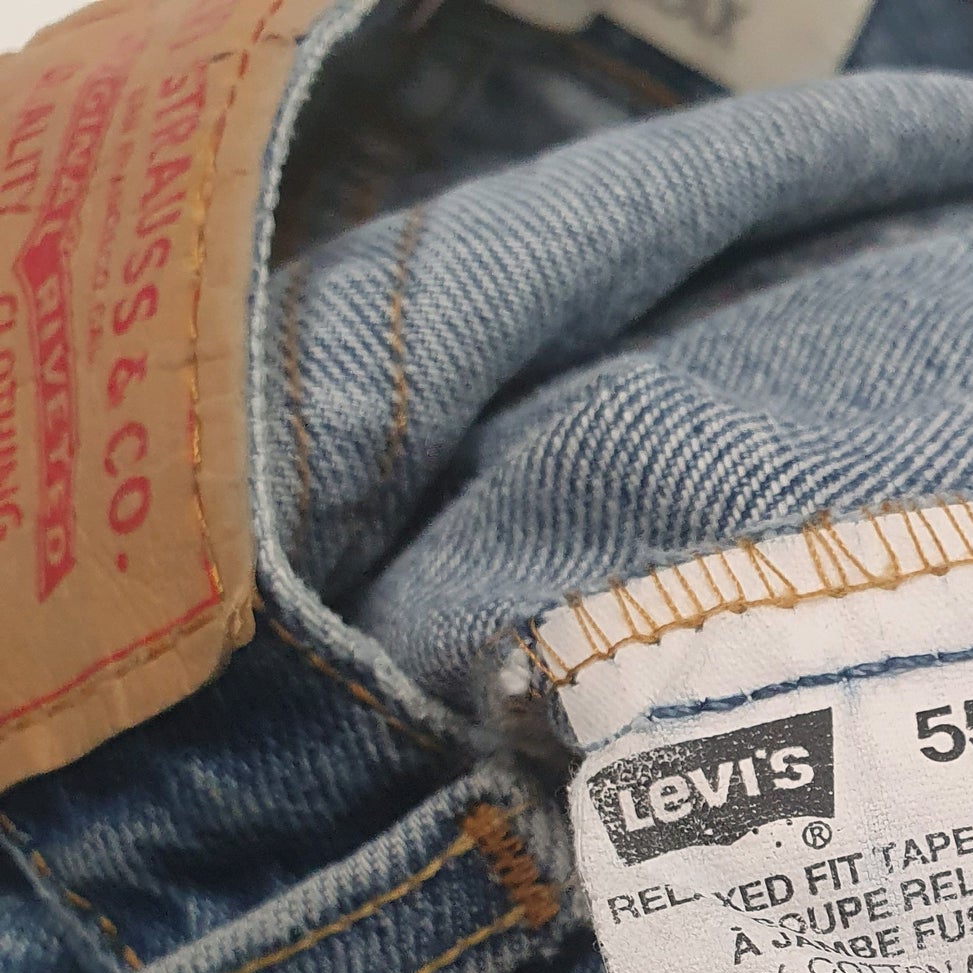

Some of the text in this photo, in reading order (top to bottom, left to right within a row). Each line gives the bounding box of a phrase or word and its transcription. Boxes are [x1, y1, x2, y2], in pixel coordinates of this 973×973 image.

[607, 873, 795, 924] RELXED
[803, 852, 863, 896] FIT
[771, 925, 905, 959] JAMBE
